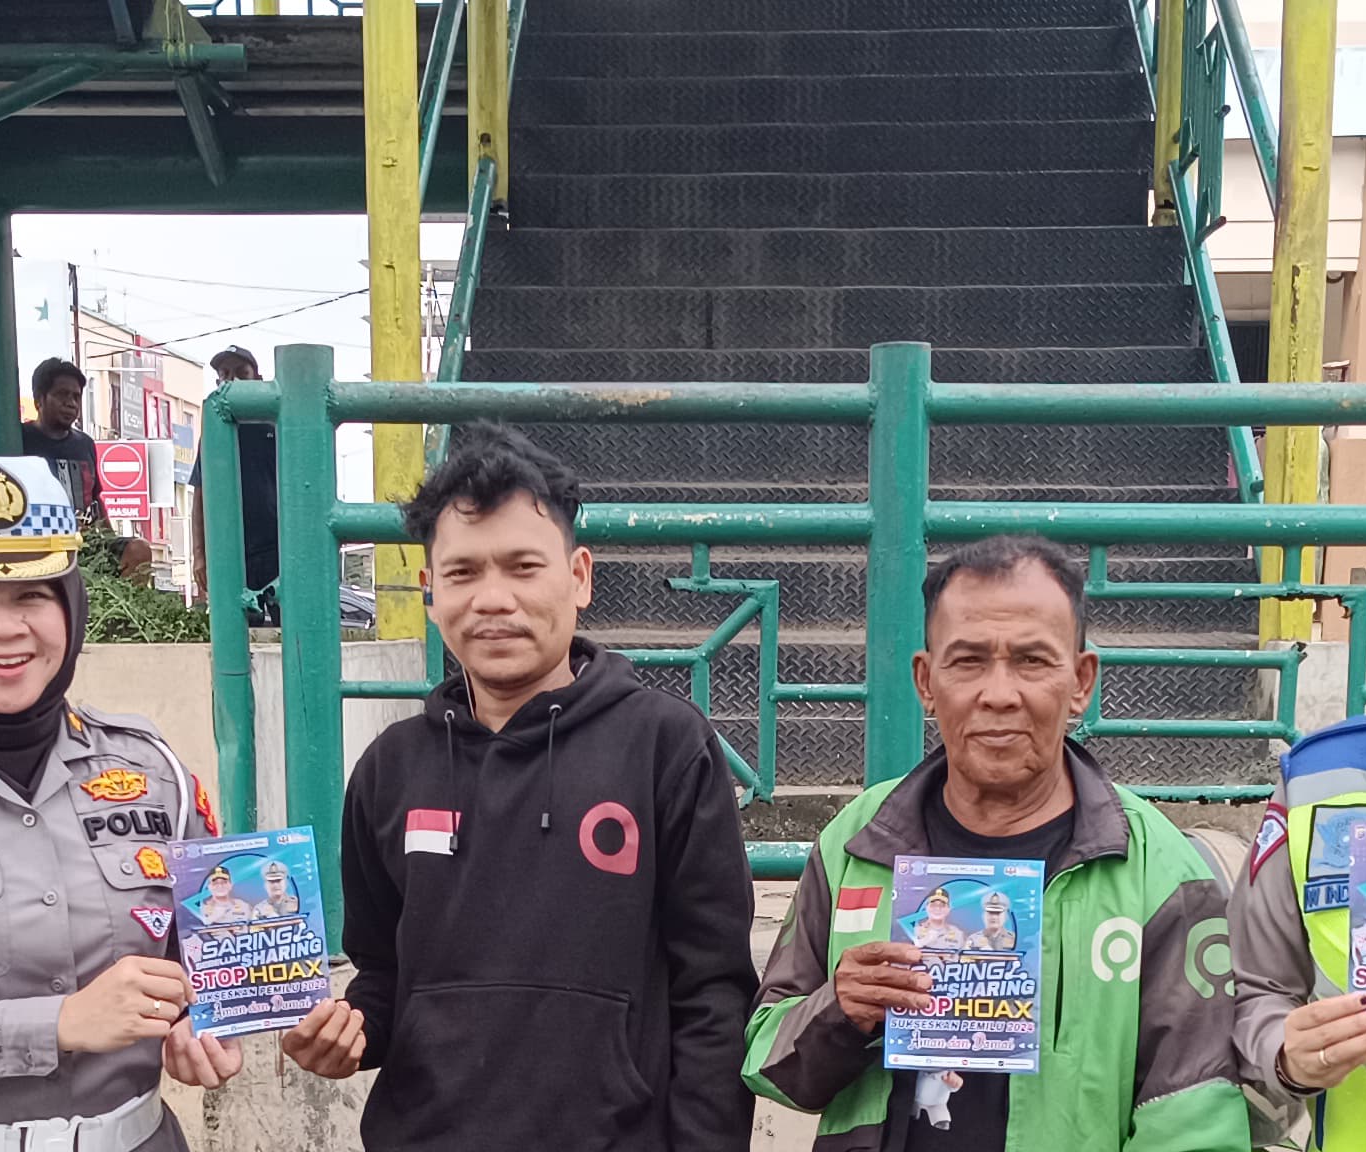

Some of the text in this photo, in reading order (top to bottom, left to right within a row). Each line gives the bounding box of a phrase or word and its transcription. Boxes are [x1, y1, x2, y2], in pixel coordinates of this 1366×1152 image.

[83, 809, 172, 842] POLRI
[202, 925, 293, 960] SARING
[240, 938, 322, 967] SHARING
[191, 959, 324, 991] STOP HOAX
[911, 961, 1006, 982] ARING
[258, 983, 301, 997] PEMILU
[300, 978, 328, 993] 2024
[947, 979, 1036, 998] SHARING
[211, 1001, 248, 1023] Aman
[270, 994, 312, 1012] Damai
[954, 998, 1033, 1019] HOAX
[890, 1018, 1036, 1033] SUKSESKAN PEMILU 2024
[907, 1029, 1016, 1051] Aman dan Damai
